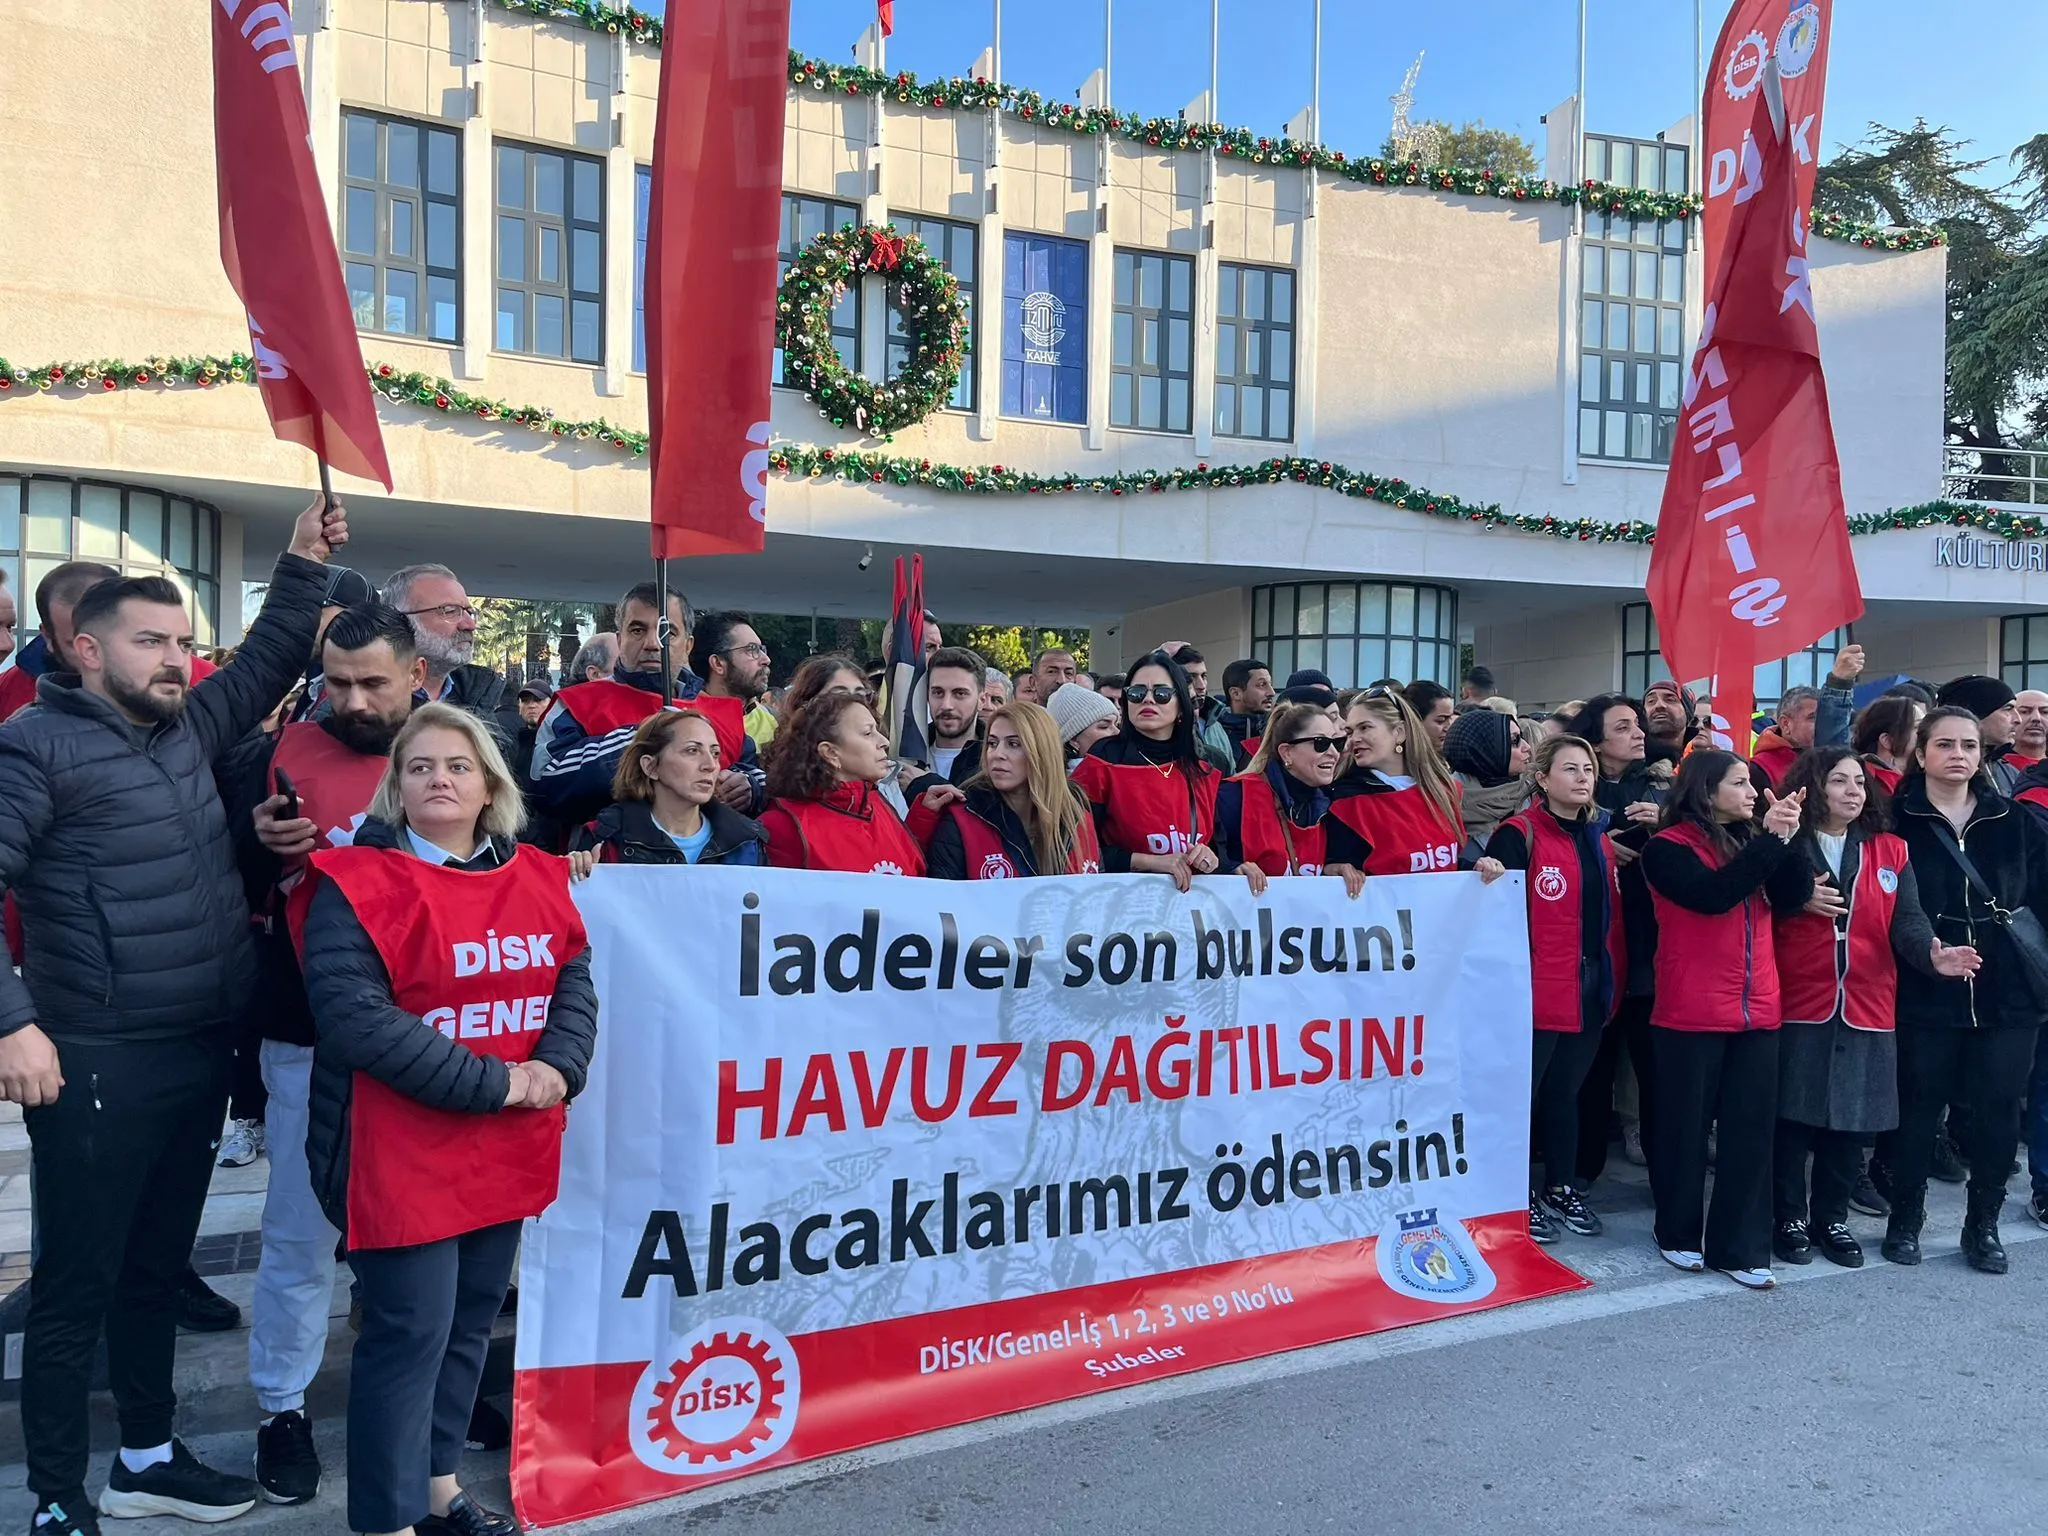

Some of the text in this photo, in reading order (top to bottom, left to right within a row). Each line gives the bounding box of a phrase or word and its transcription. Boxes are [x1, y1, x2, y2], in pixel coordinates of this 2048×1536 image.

[1733, 54, 1758, 75] DİSK
[1026, 351, 1060, 364] KAHVE
[452, 929, 555, 978] DİSK
[739, 892, 1416, 997] İadeler son bulsun!
[422, 995, 552, 1040] GENE
[716, 1015, 1425, 1145] HAVUZ DAĞITILSIN!
[621, 1112, 1469, 1298] Alacaklarımız ödensin!
[919, 1313, 1102, 1375] DİSK/Genel-İş
[1106, 1313, 1130, 1340] 1,
[1133, 1308, 1158, 1335] 2,
[1160, 1304, 1178, 1329] 3
[1180, 1303, 1211, 1324] ve
[1212, 1295, 1229, 1318] 9
[1084, 1345, 1187, 1378] Şubeler
[676, 1377, 755, 1416] DİSK
